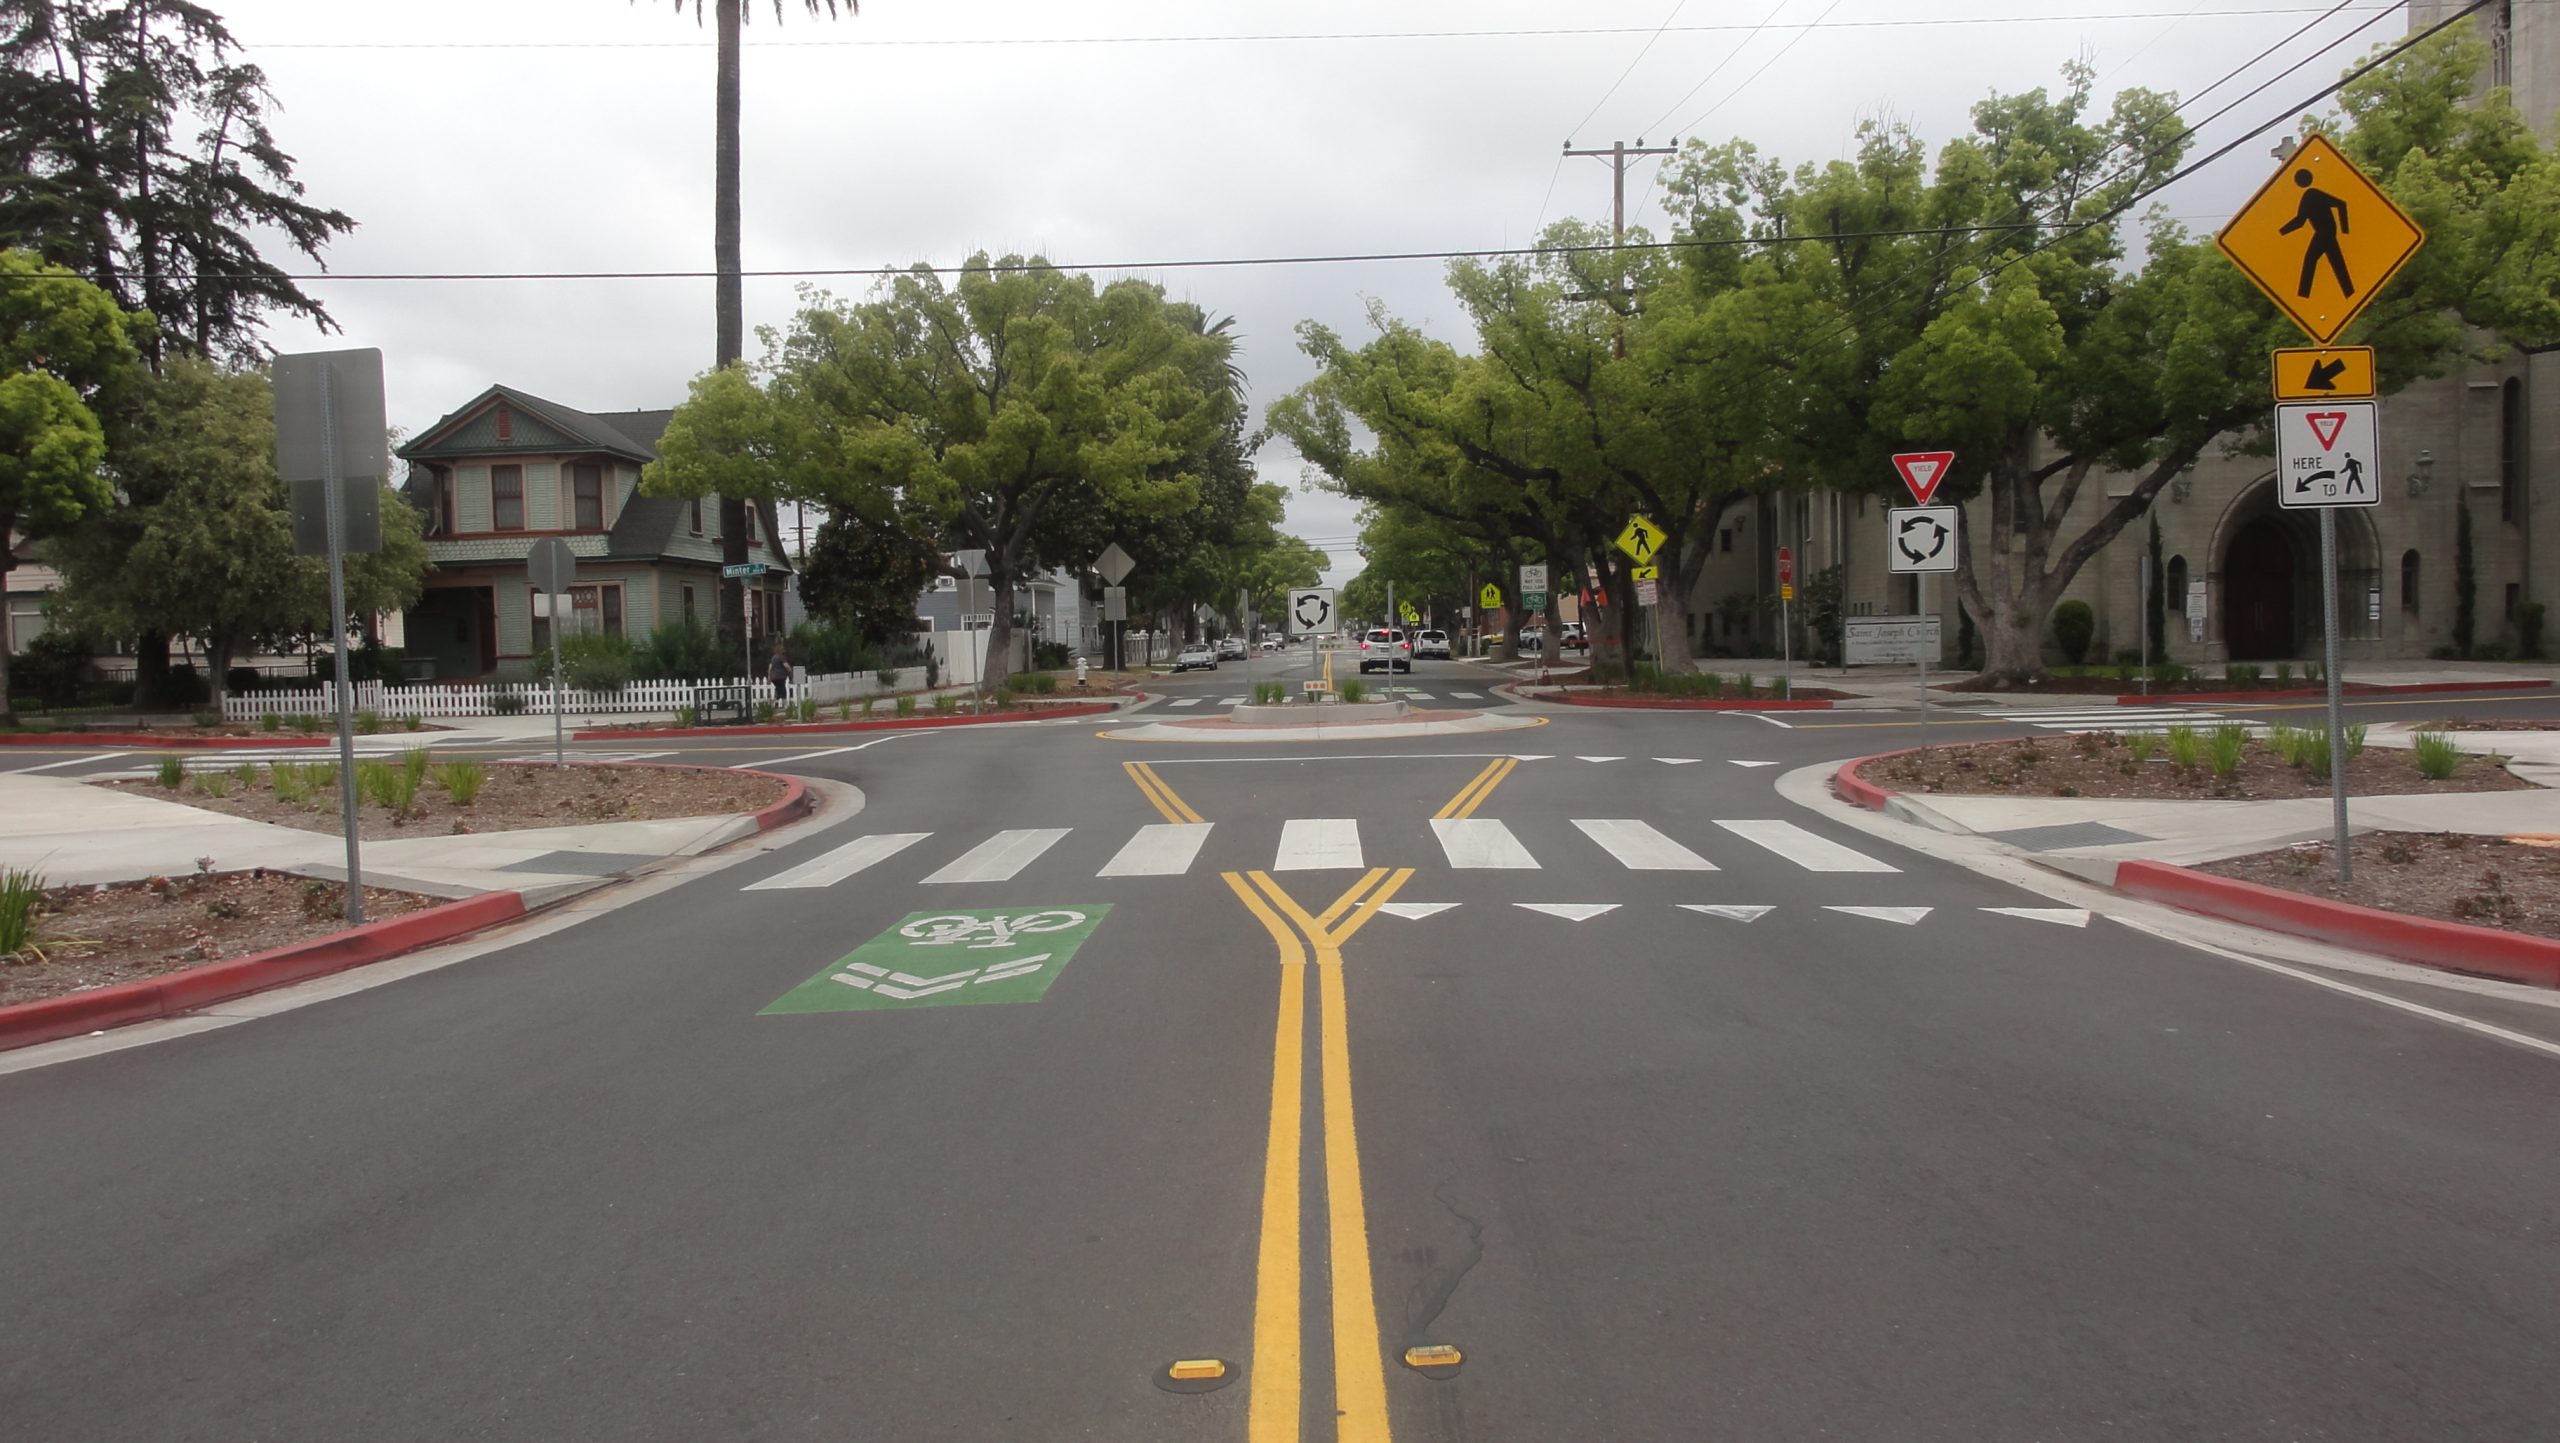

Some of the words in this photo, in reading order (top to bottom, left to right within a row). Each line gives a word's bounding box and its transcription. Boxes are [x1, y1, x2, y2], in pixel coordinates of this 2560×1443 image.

[2293, 457, 2323, 469] HERE
[2323, 484, 2337, 497] TO
[725, 566, 751, 576] Minter
[1847, 627, 1873, 638] Saint
[1874, 626, 1905, 640] Joseph
